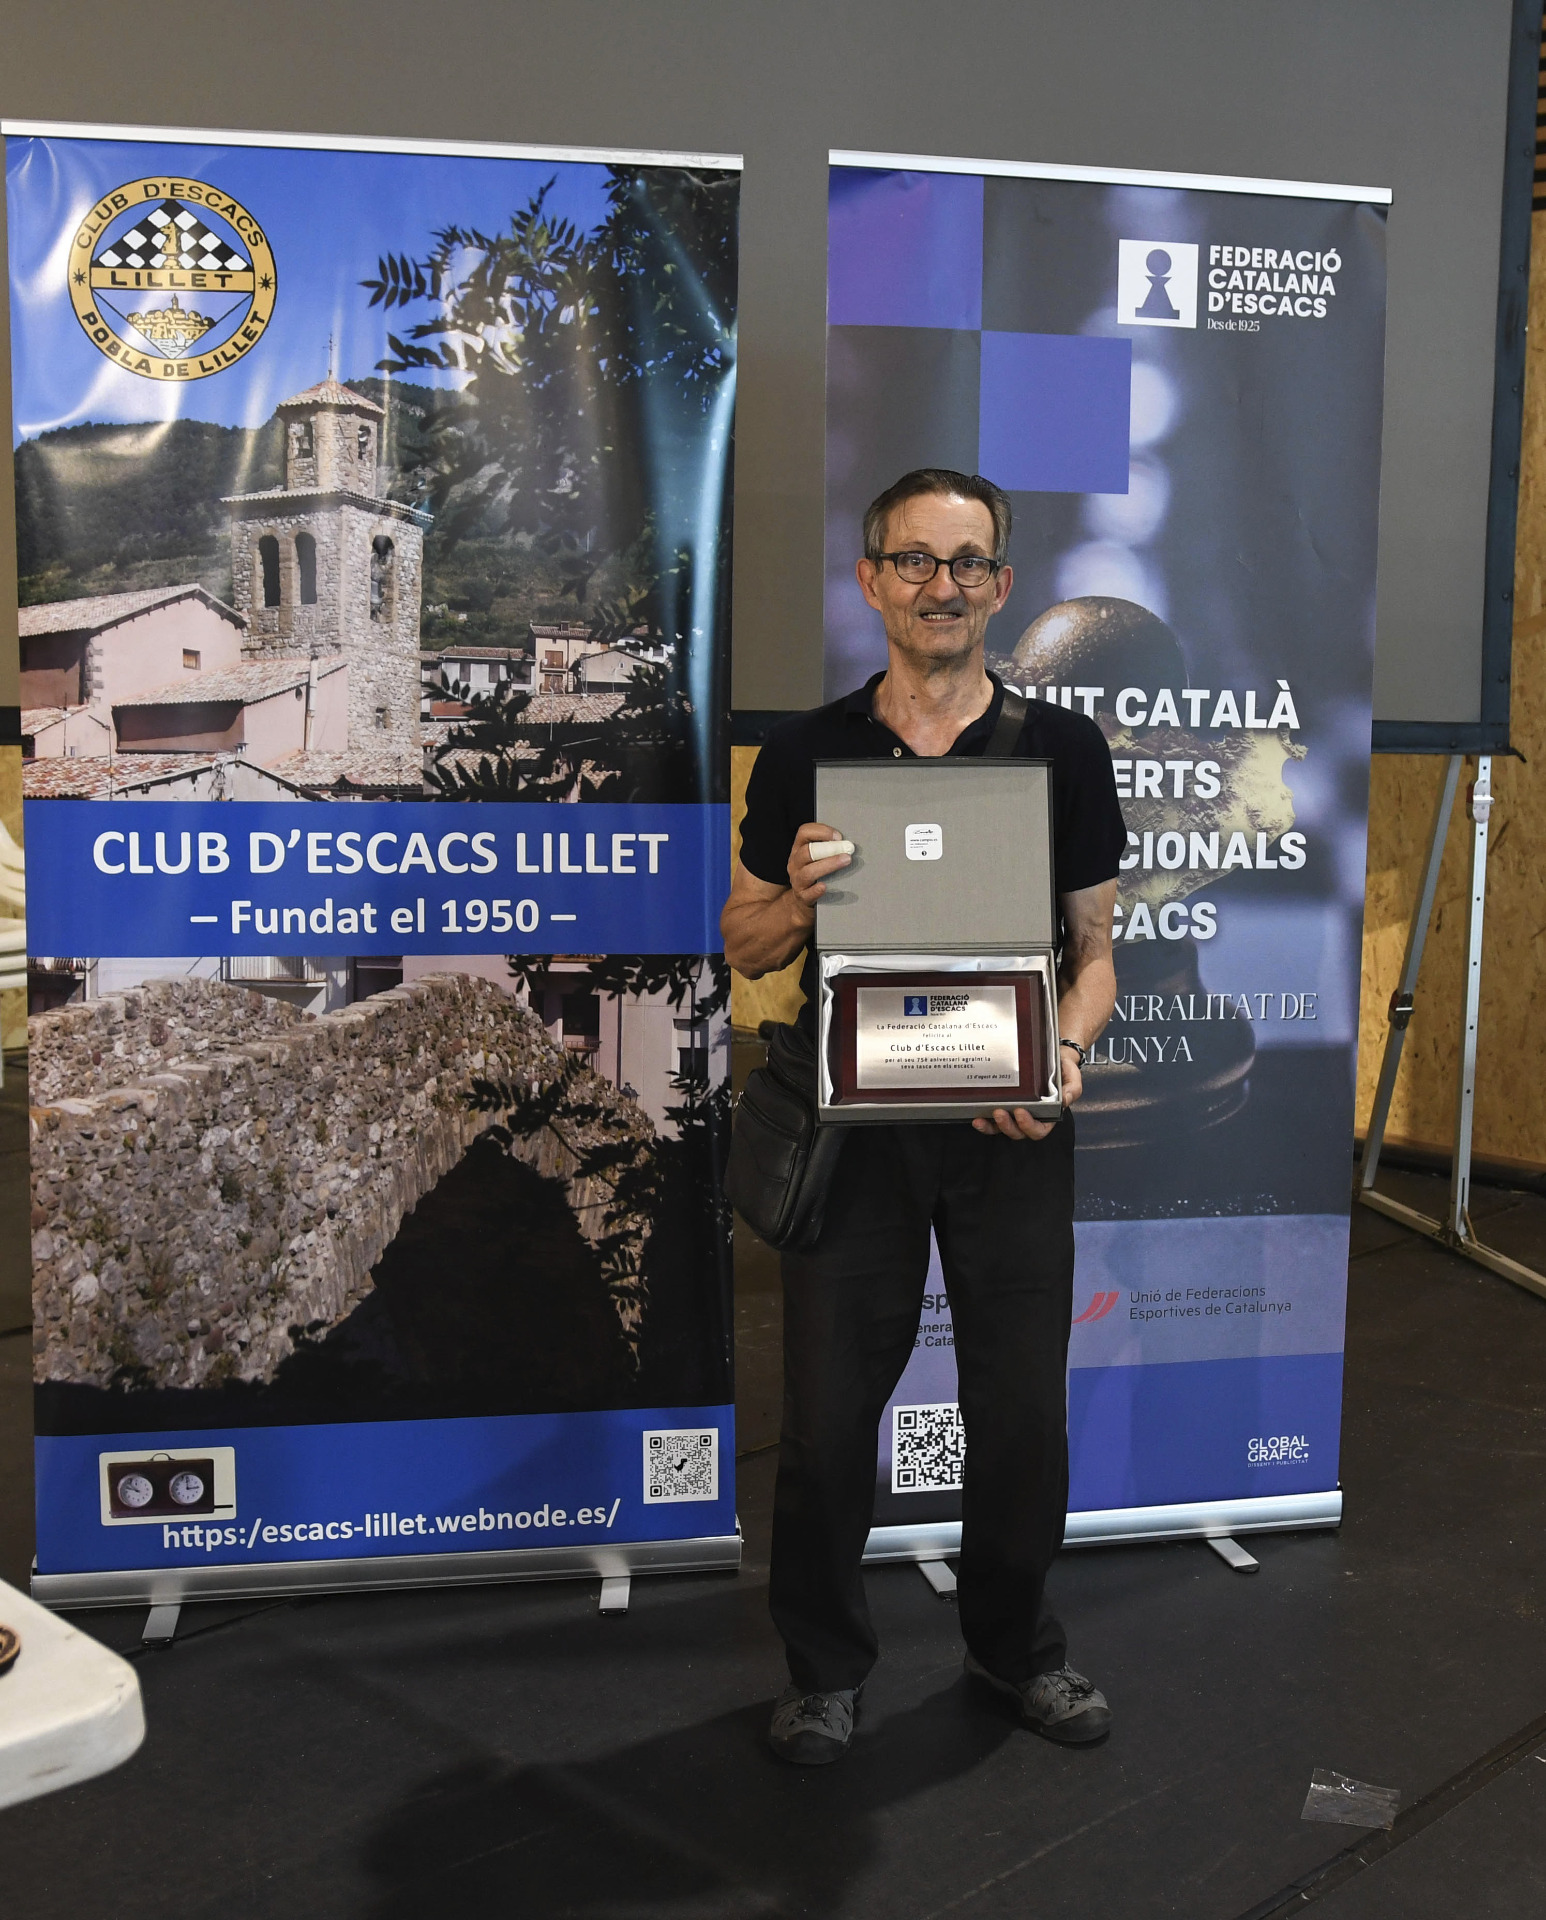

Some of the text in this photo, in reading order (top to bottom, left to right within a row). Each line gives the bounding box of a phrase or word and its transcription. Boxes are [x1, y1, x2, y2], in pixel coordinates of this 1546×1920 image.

[77, 183, 264, 249] CLUB D'ESCACS
[1209, 245, 1342, 273] FEDERACIÓ
[111, 271, 233, 288] LILLET
[1208, 268, 1336, 295] CATALANA
[1208, 291, 1327, 318] D'ESCACS
[1238, 319, 1260, 332] 1925
[82, 311, 266, 376] POBLA DE LILLET
[1115, 679, 1300, 729] CATALÀ
[93, 829, 669, 875] CLUB D'ESCACS LILLET
[231, 898, 377, 934] Fundat
[391, 898, 425, 934] el
[442, 899, 540, 934] 1950
[1280, 992, 1318, 1021] DE
[929, 1022, 962, 1030] Catalana
[890, 1043, 986, 1052] Club d'Escacs Lillet
[1083, 1036, 1193, 1065] LUNYA
[1130, 1285, 1266, 1303] Unió de Federacions
[1129, 1301, 1292, 1322] Esportives de Catalunya
[1248, 1434, 1310, 1450] GLOBAL
[163, 1498, 621, 1552] https:/escacs-lillet.webnode.es/
